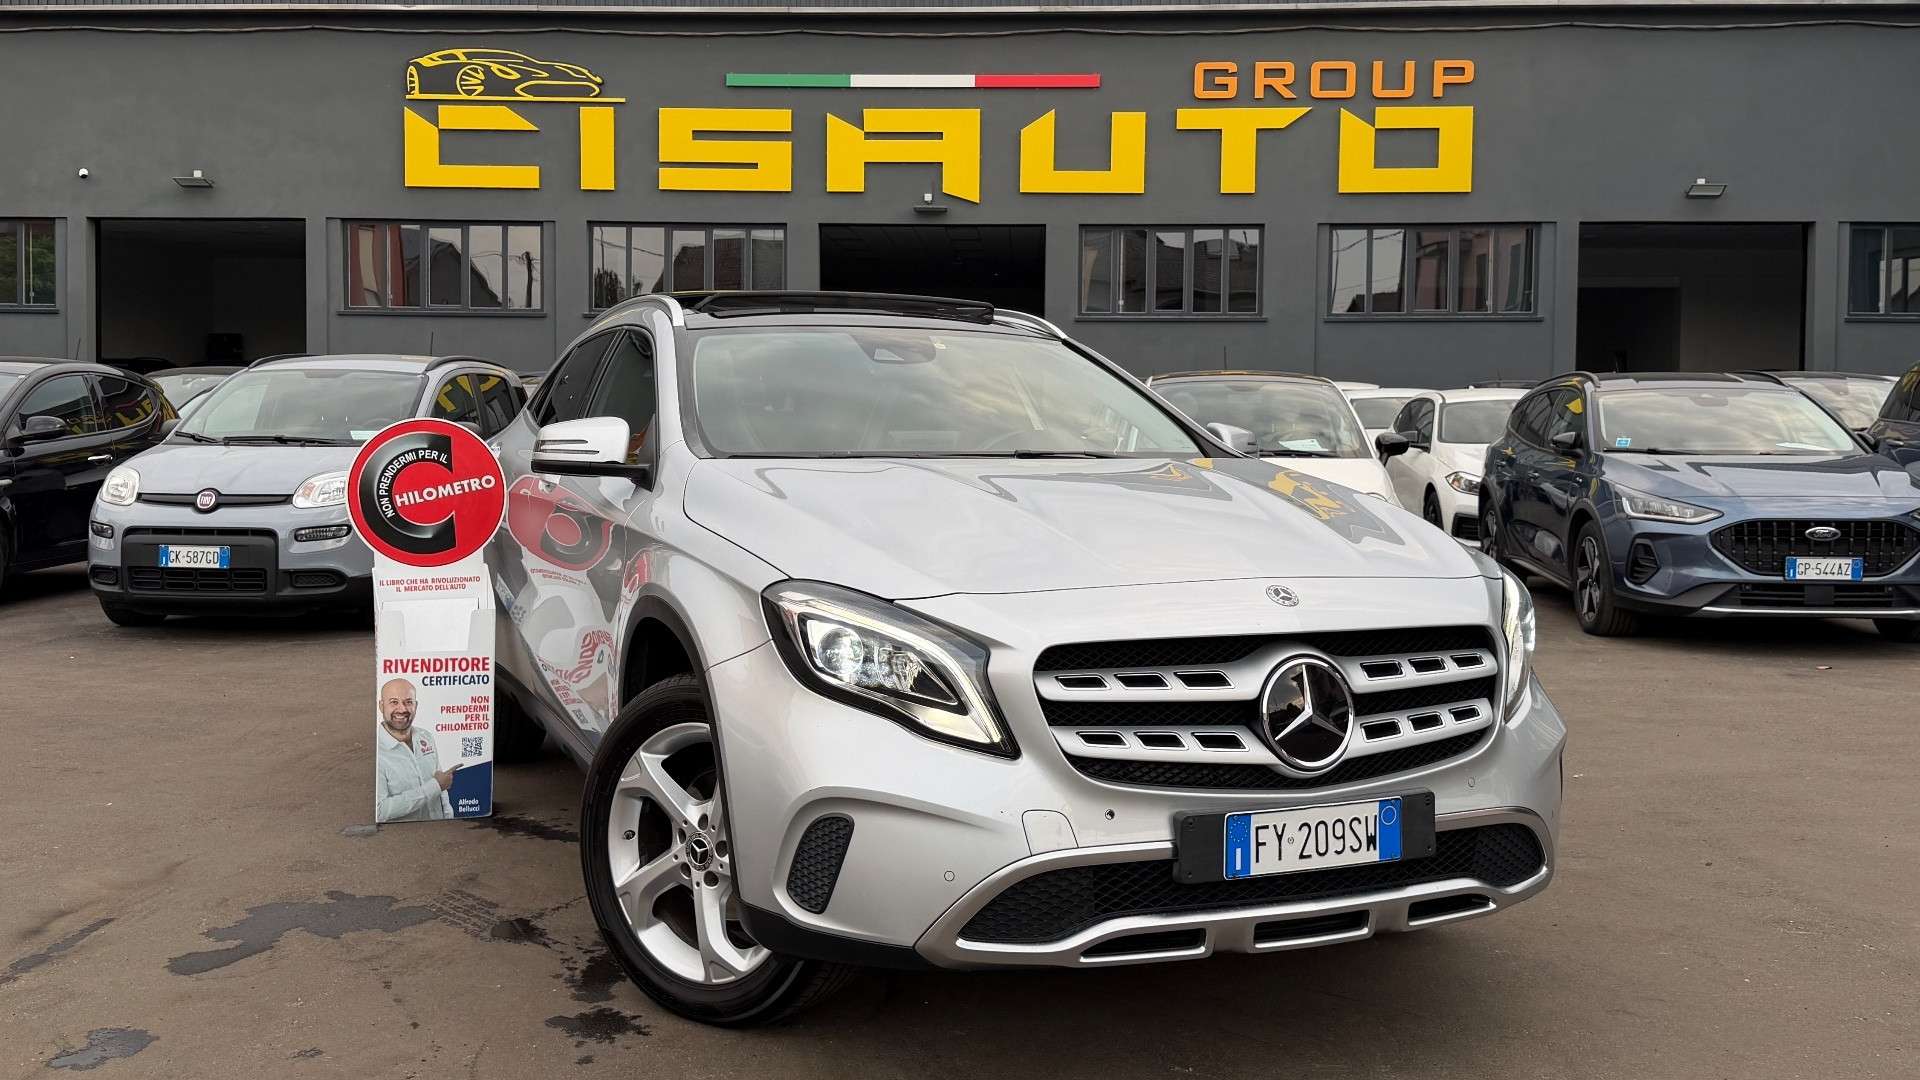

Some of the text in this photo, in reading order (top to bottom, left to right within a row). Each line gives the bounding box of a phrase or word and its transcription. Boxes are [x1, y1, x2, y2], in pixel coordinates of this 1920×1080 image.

[1194, 60, 1475, 99] GROUP
[379, 449, 448, 518] NON PRENDERMI PER IL
[431, 576, 480, 584] RIVOLUZIONATO
[404, 584, 433, 592] MERCATO
[383, 657, 490, 673] RIVENDITORE
[422, 674, 490, 686] CERTIFICATO
[471, 695, 490, 704] NON
[440, 705, 489, 714] PRENDERMI
[435, 722, 489, 732] CHILOMETRO
